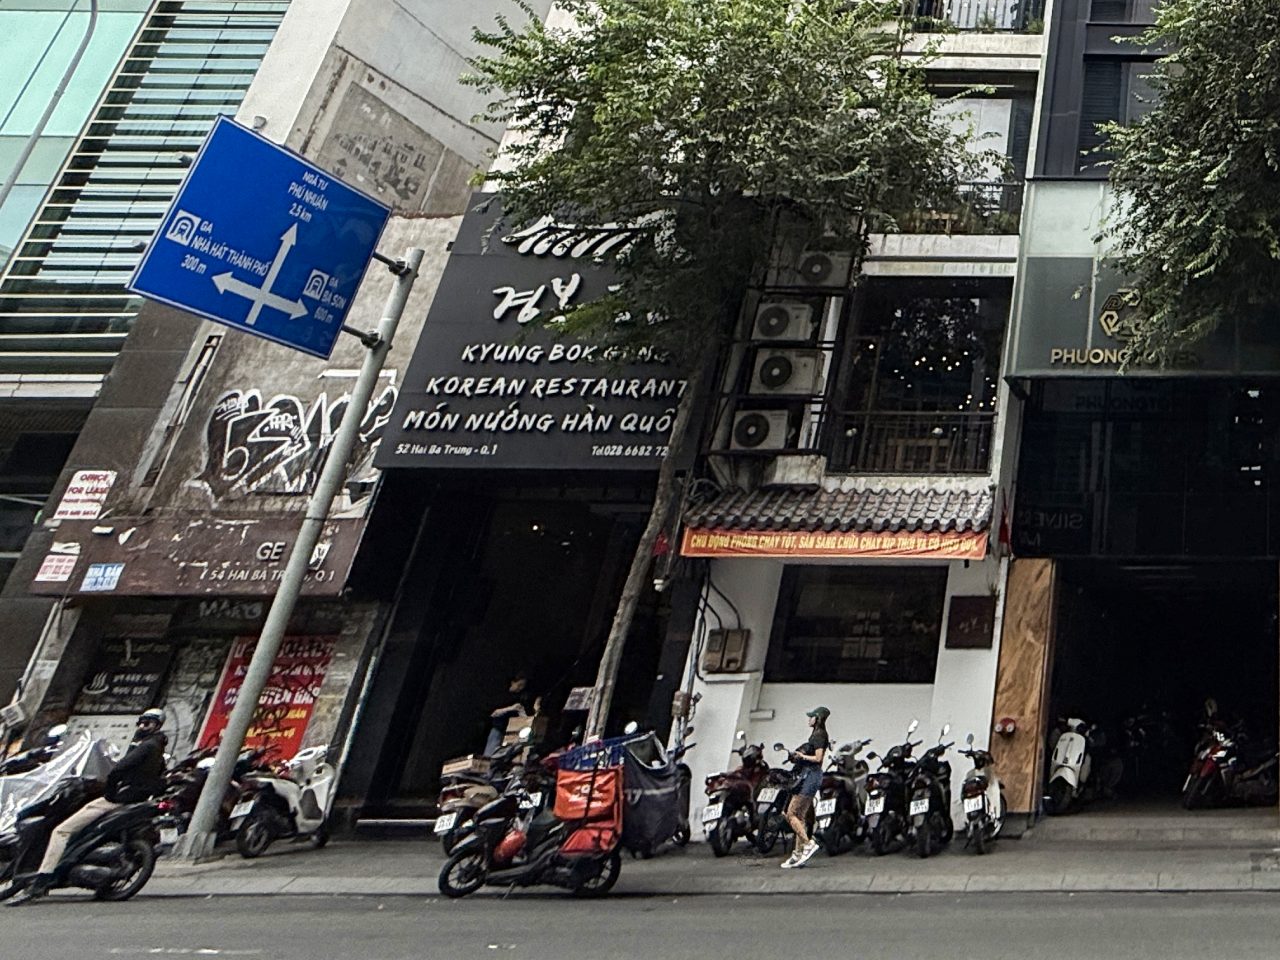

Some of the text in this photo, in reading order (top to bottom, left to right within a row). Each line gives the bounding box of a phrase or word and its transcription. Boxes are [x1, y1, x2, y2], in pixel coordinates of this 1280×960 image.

[200, 221, 214, 234] GA
[181, 254, 207, 275] 300 m
[461, 343, 545, 363] KYUNG
[425, 377, 688, 399] KOREAN RESTAURANT
[402, 401, 460, 432] MÓN
[561, 404, 614, 433] HÀN
[395, 444, 410, 455] 52
[410, 444, 427, 455] Hai
[444, 444, 473, 456] Trung
[625, 445, 652, 456] 6682
[227, 569, 252, 580] HAI
